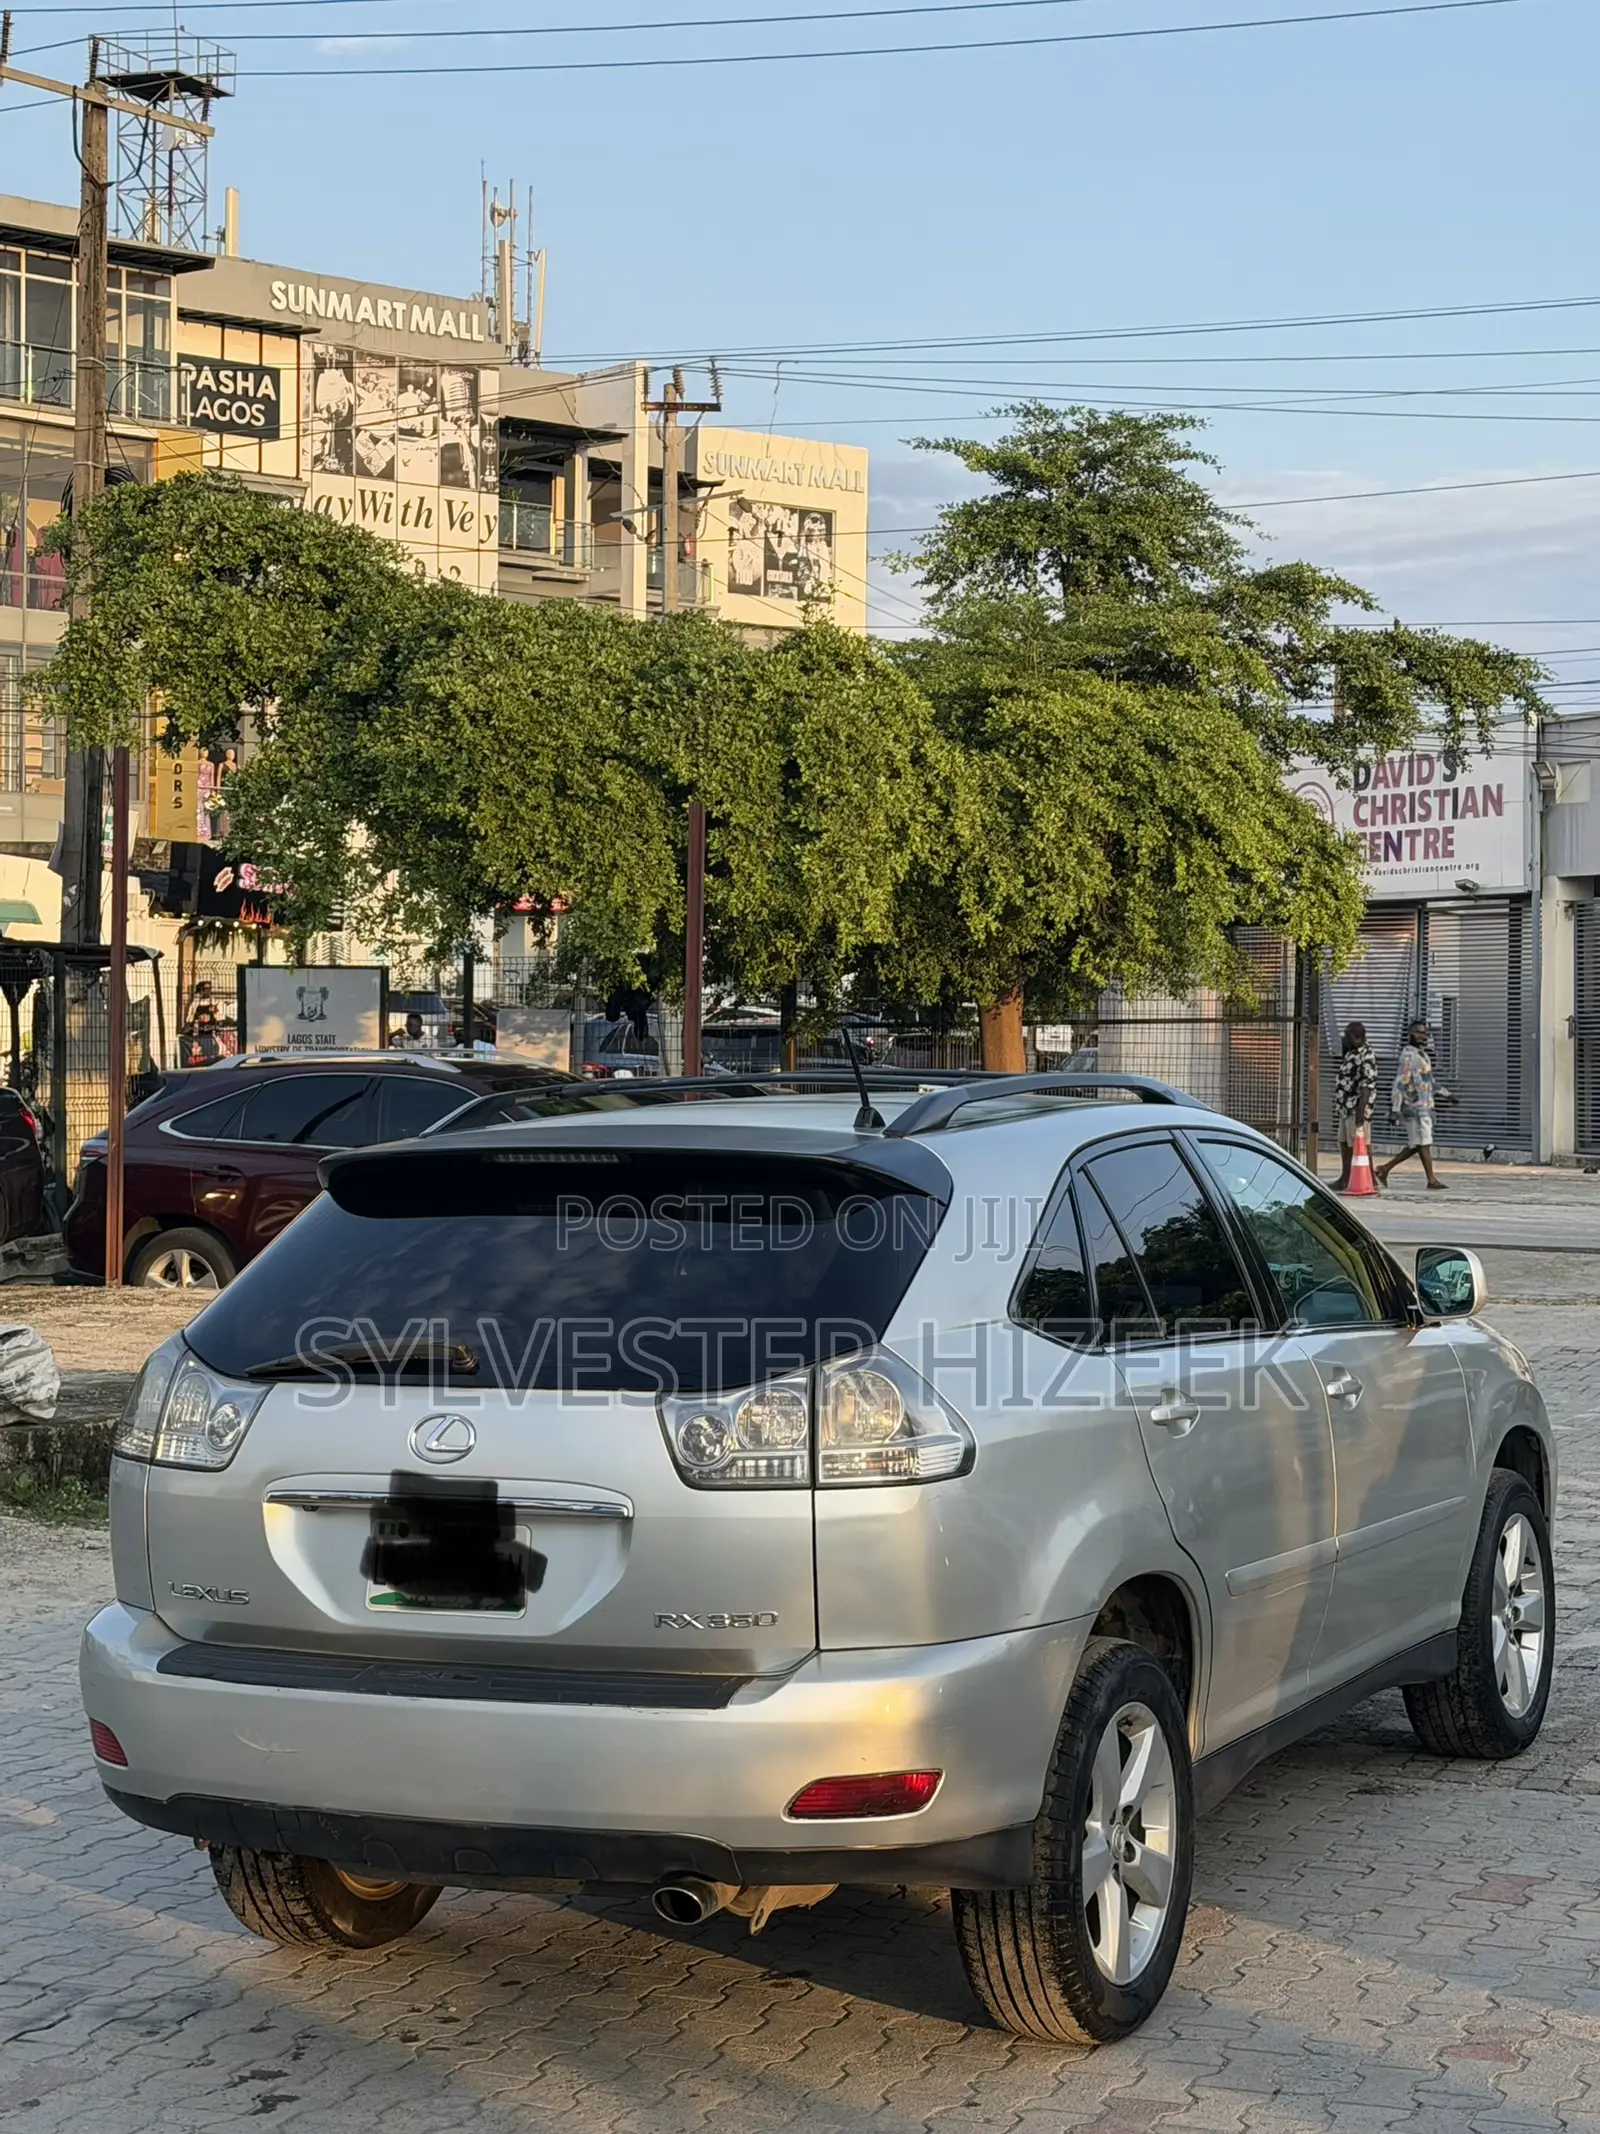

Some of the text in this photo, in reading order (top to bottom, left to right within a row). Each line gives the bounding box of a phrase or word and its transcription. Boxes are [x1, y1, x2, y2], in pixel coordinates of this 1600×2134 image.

[270, 280, 485, 342] SUNMART MALL
[180, 362, 277, 401] PASHA
[180, 393, 265, 427] LAGOS
[703, 451, 865, 494] SUNMART MALL
[1352, 783, 1504, 828] CHRISTIAN
[287, 1033, 337, 1045] LAGOS STATE
[167, 1580, 250, 1605] LEXUS
